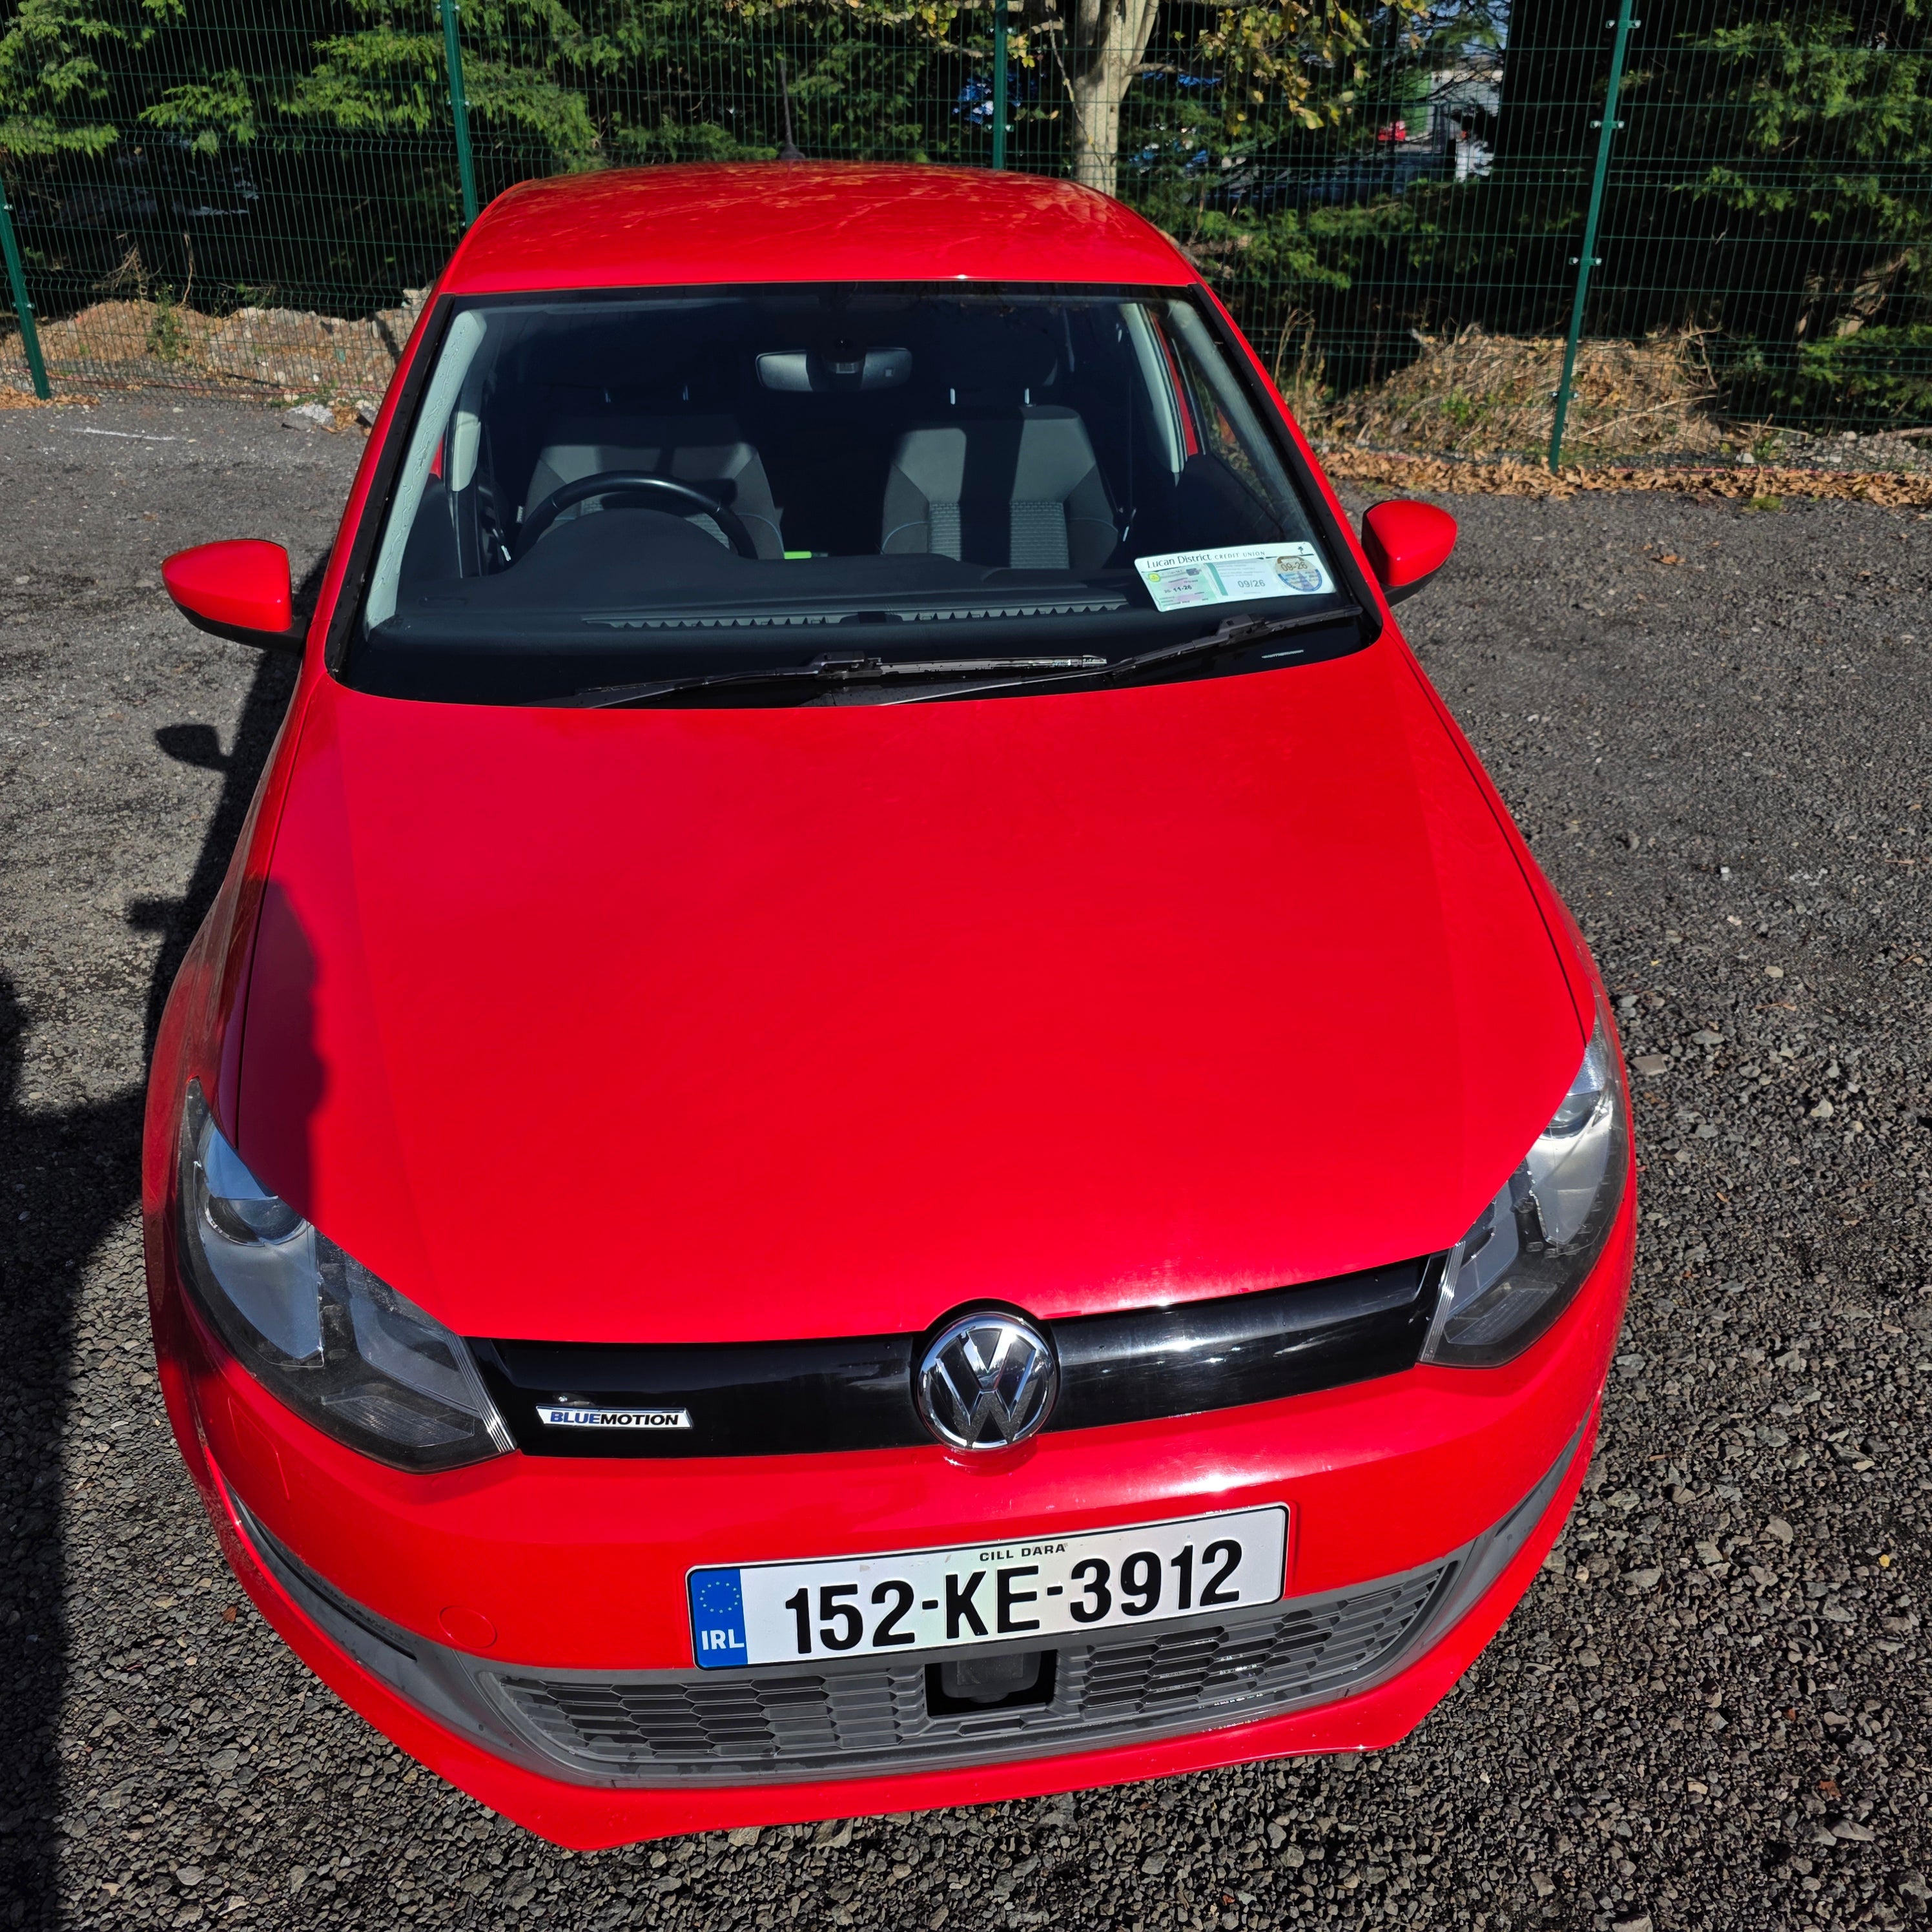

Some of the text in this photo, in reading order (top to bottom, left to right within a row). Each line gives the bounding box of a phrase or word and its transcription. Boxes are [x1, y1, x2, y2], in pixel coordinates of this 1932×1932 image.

[1147, 559, 1175, 569] Lucan
[1177, 553, 1212, 564] District
[1280, 561, 1308, 571] 09-26
[1237, 579, 1266, 588] 09/26
[550, 1411, 679, 1426] BLUEMOTION
[980, 1543, 1066, 1562] CILL DARA
[785, 1539, 1242, 1654] 152-KE-3912
[701, 1629, 745, 1650] IRL
